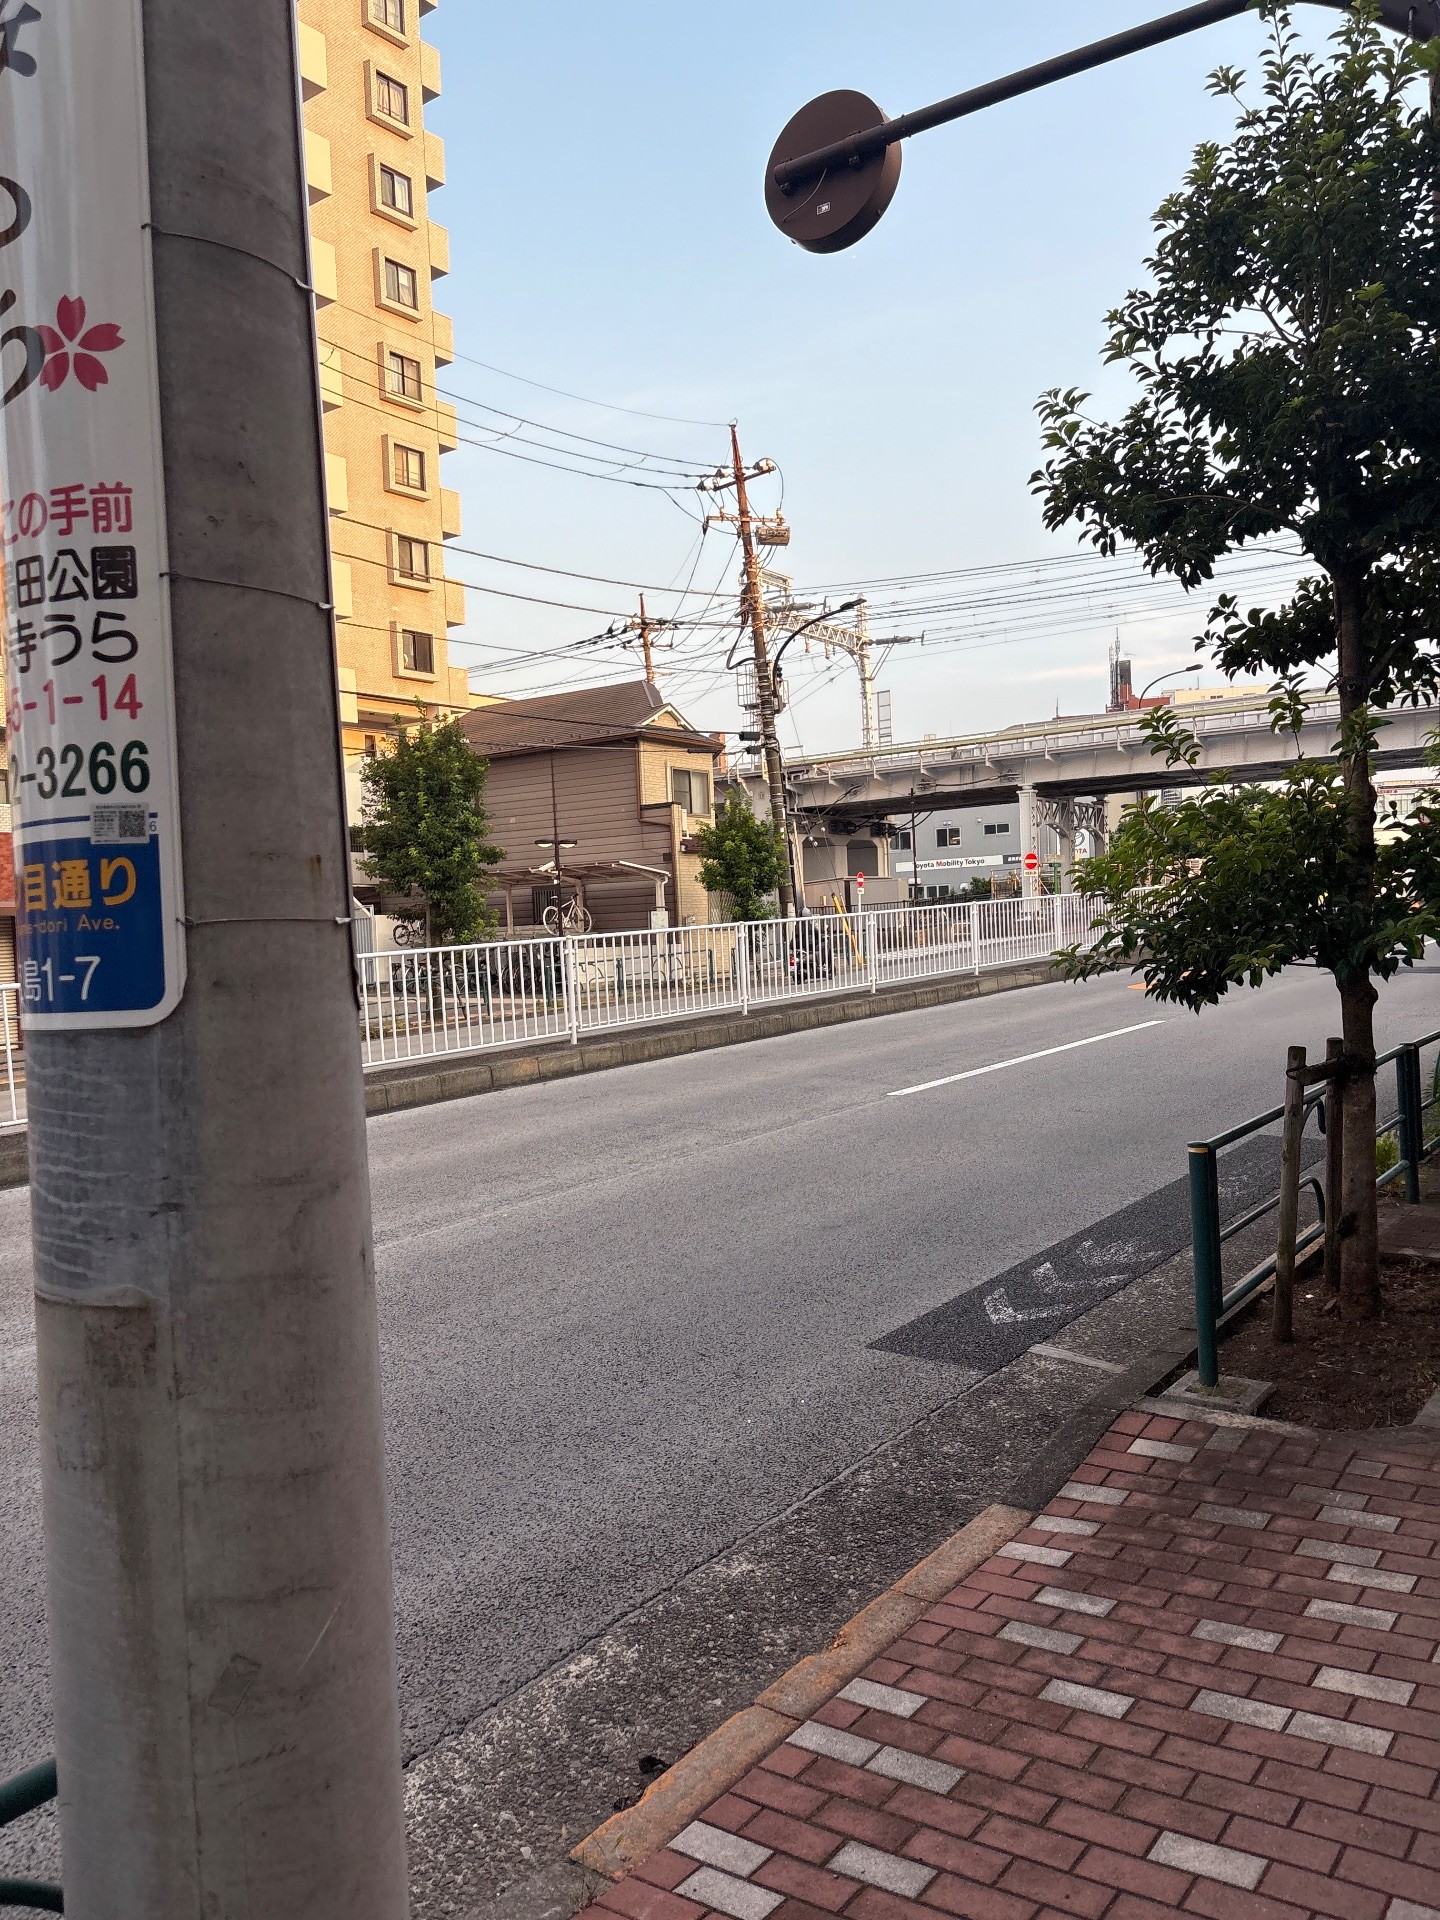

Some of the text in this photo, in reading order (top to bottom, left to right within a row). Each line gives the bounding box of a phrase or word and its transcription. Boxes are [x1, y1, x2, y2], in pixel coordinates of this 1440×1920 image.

[935, 859, 963, 867] Mobility
[965, 858, 985, 866] Tokyo
[77, 913, 120, 931] Ave.
